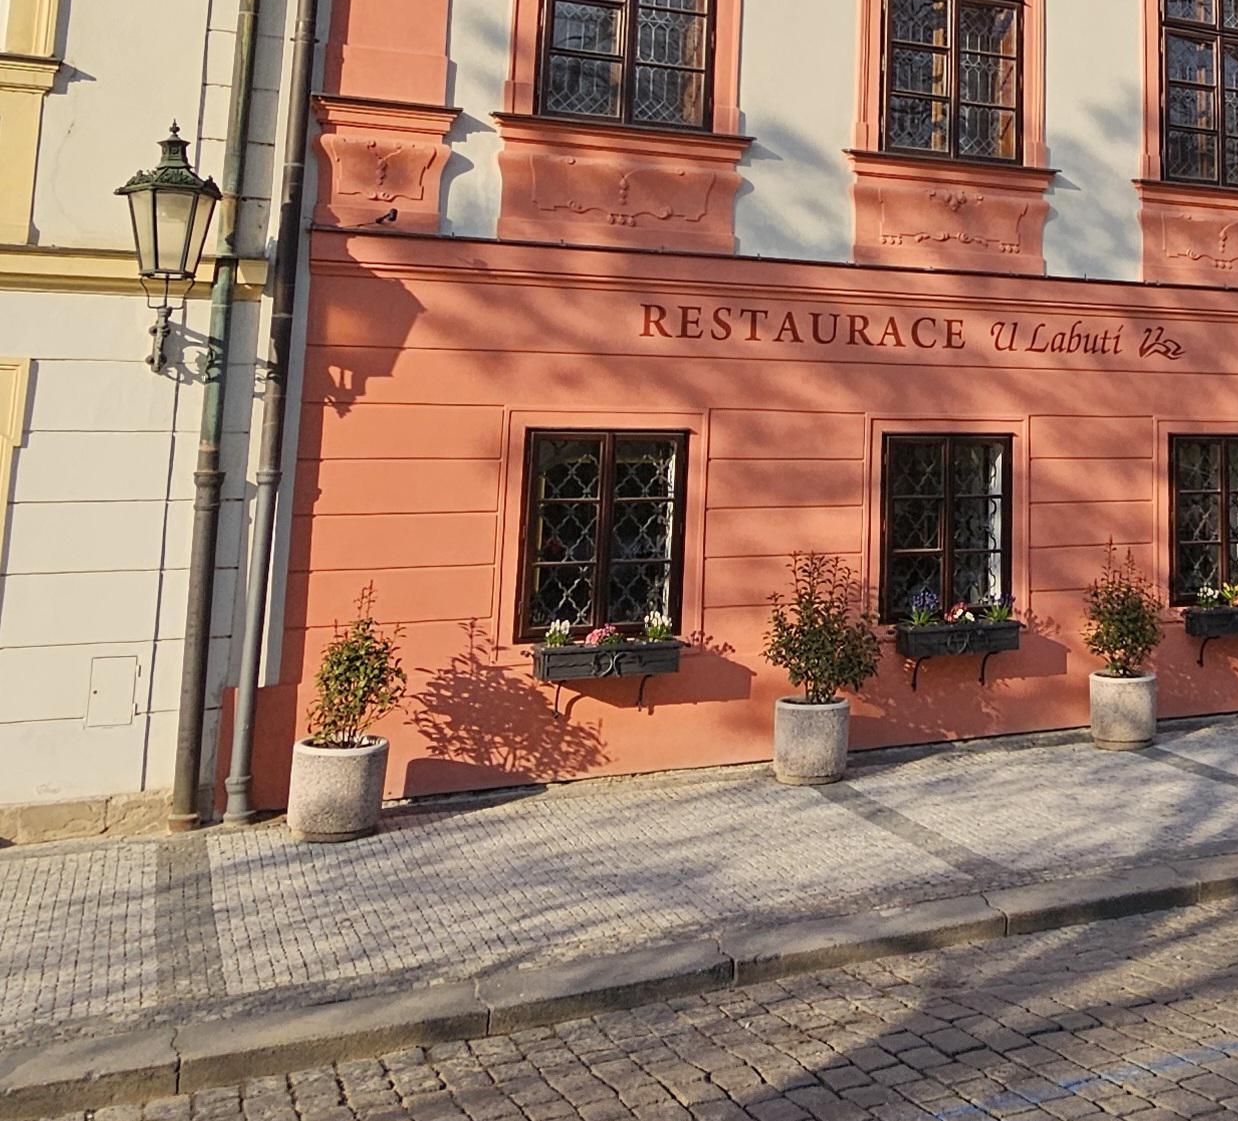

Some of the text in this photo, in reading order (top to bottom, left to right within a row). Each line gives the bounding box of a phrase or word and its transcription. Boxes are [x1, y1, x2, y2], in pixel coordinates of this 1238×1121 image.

[639, 303, 1124, 355] RESTAURACE U Labutí
